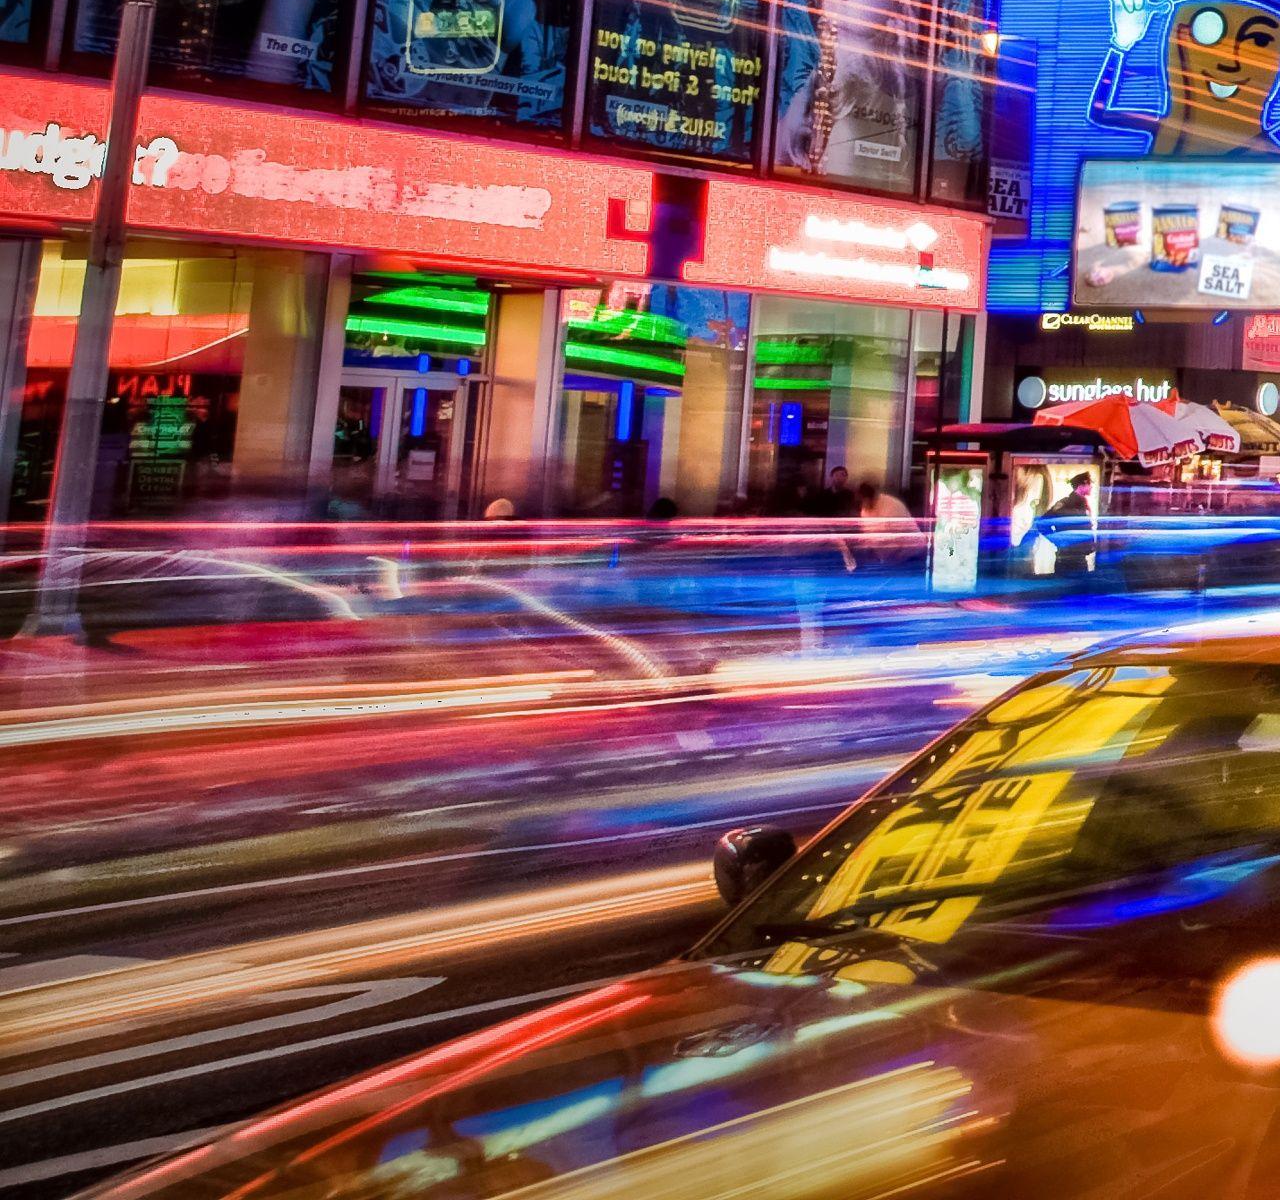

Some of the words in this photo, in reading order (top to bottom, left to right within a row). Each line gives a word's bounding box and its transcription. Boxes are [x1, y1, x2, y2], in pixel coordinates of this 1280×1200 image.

[267, 37, 289, 52] The
[291, 41, 315, 60] City
[475, 73, 516, 92] Fantasy
[1212, 264, 1240, 281] SEA
[1203, 278, 1245, 295] SALT
[1136, 377, 1172, 403] hut
